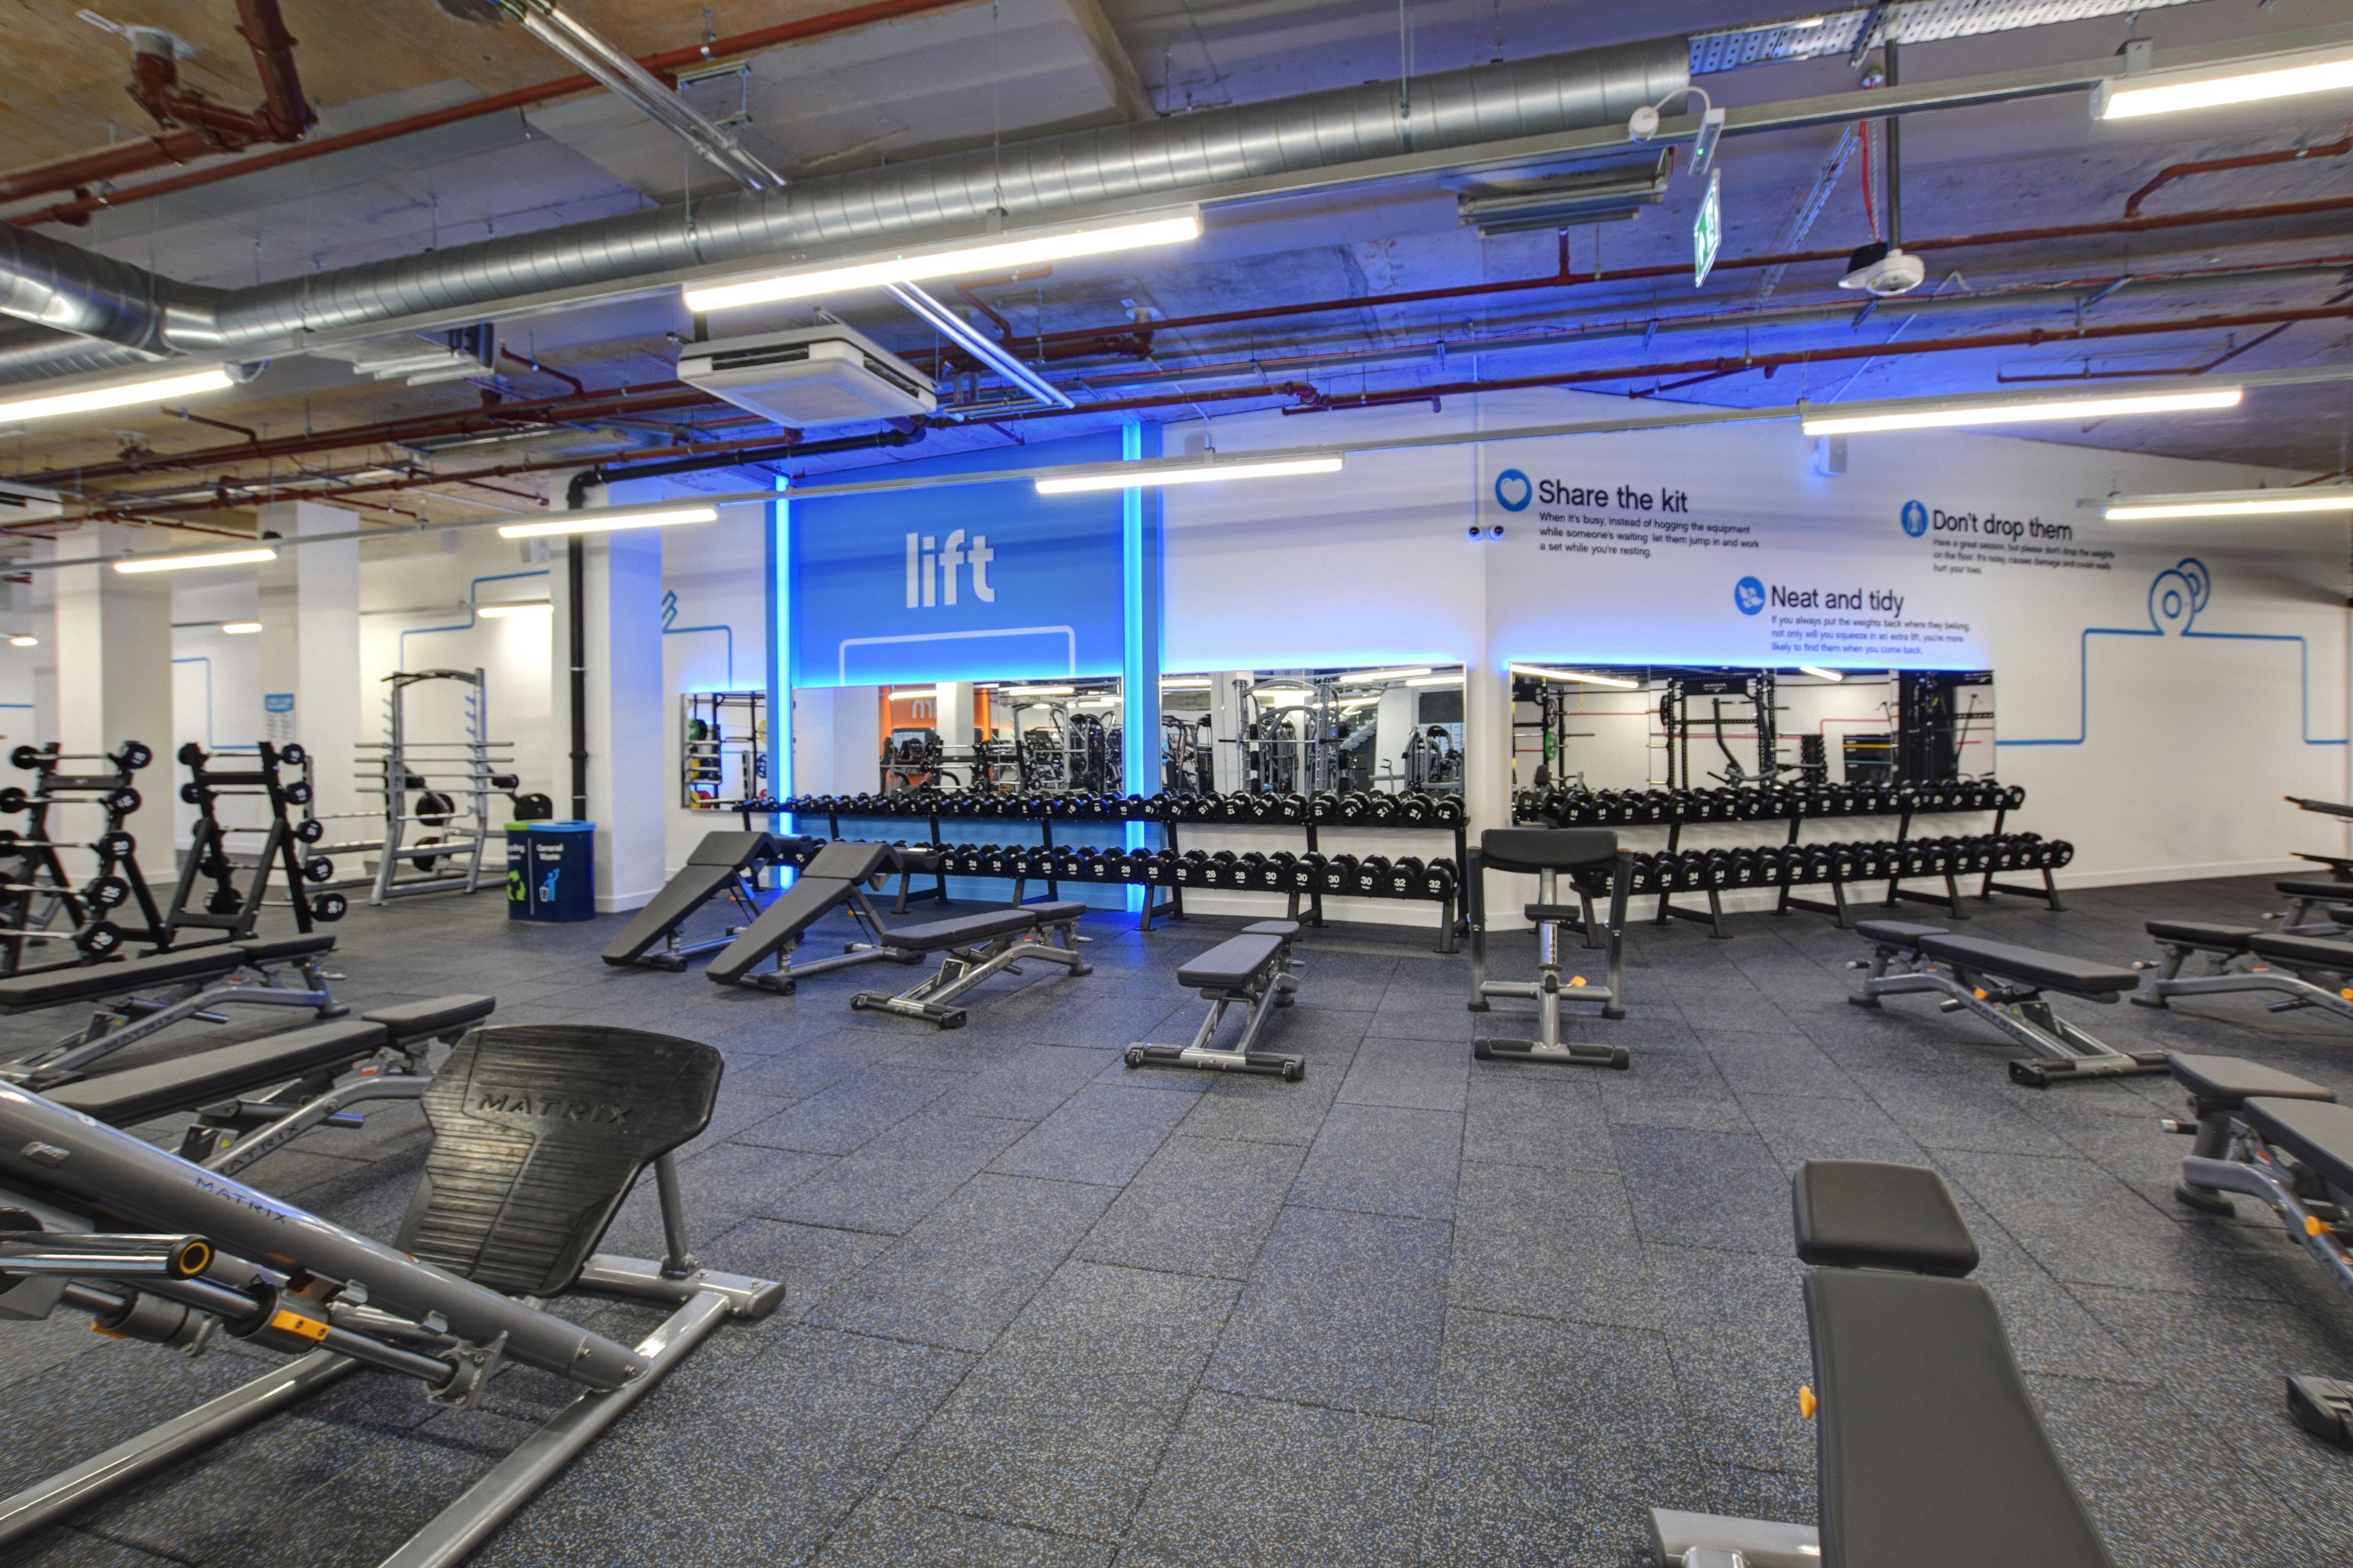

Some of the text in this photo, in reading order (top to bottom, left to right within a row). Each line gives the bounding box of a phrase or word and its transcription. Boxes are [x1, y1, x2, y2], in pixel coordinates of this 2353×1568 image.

[1539, 479, 1689, 512] Share the kit
[1540, 512, 1751, 534] When it's busy, instead of hogging the equipment
[1933, 510, 2072, 542] Don't drop them
[1540, 527, 1563, 536] while
[1566, 530, 1614, 539] someone's
[1653, 533, 1663, 542] let
[1666, 534, 1687, 543] them
[1689, 536, 1711, 547] jump
[1723, 538, 1738, 546] and
[1566, 542, 1589, 552] while
[1592, 545, 1617, 555] you're
[1620, 546, 1652, 558] resting.
[906, 529, 995, 608] lift
[1772, 585, 1904, 617] Neat and tidy
[1779, 617, 1793, 626] you
[1796, 616, 1821, 627] always
[1825, 618, 1836, 627] put
[1853, 618, 1881, 628] weights
[1929, 621, 1942, 631] they
[1788, 630, 1803, 640] only
[1820, 632, 1834, 641] you
[1836, 632, 1867, 641] squeeze
[1772, 642, 1792, 653] likely
[1805, 643, 1818, 652] find
[1821, 643, 1840, 652] them
[1843, 644, 1863, 652] when
[1866, 647, 1879, 655] you
[1206, 870, 1216, 878] 28
[1266, 872, 1277, 880] 30
[1296, 873, 1307, 882] 30
[1328, 875, 1340, 883] 30
[1633, 875, 1644, 884] 32
[1661, 874, 1672, 883] 34
[1689, 872, 1698, 881] 34
[1715, 870, 1725, 879] 34
[1360, 876, 1372, 885] 30
[1394, 878, 1406, 887] 32
[1429, 880, 1440, 888] 32
[478, 1093, 633, 1125] MATRIX
[196, 1178, 286, 1224] MATRIX
